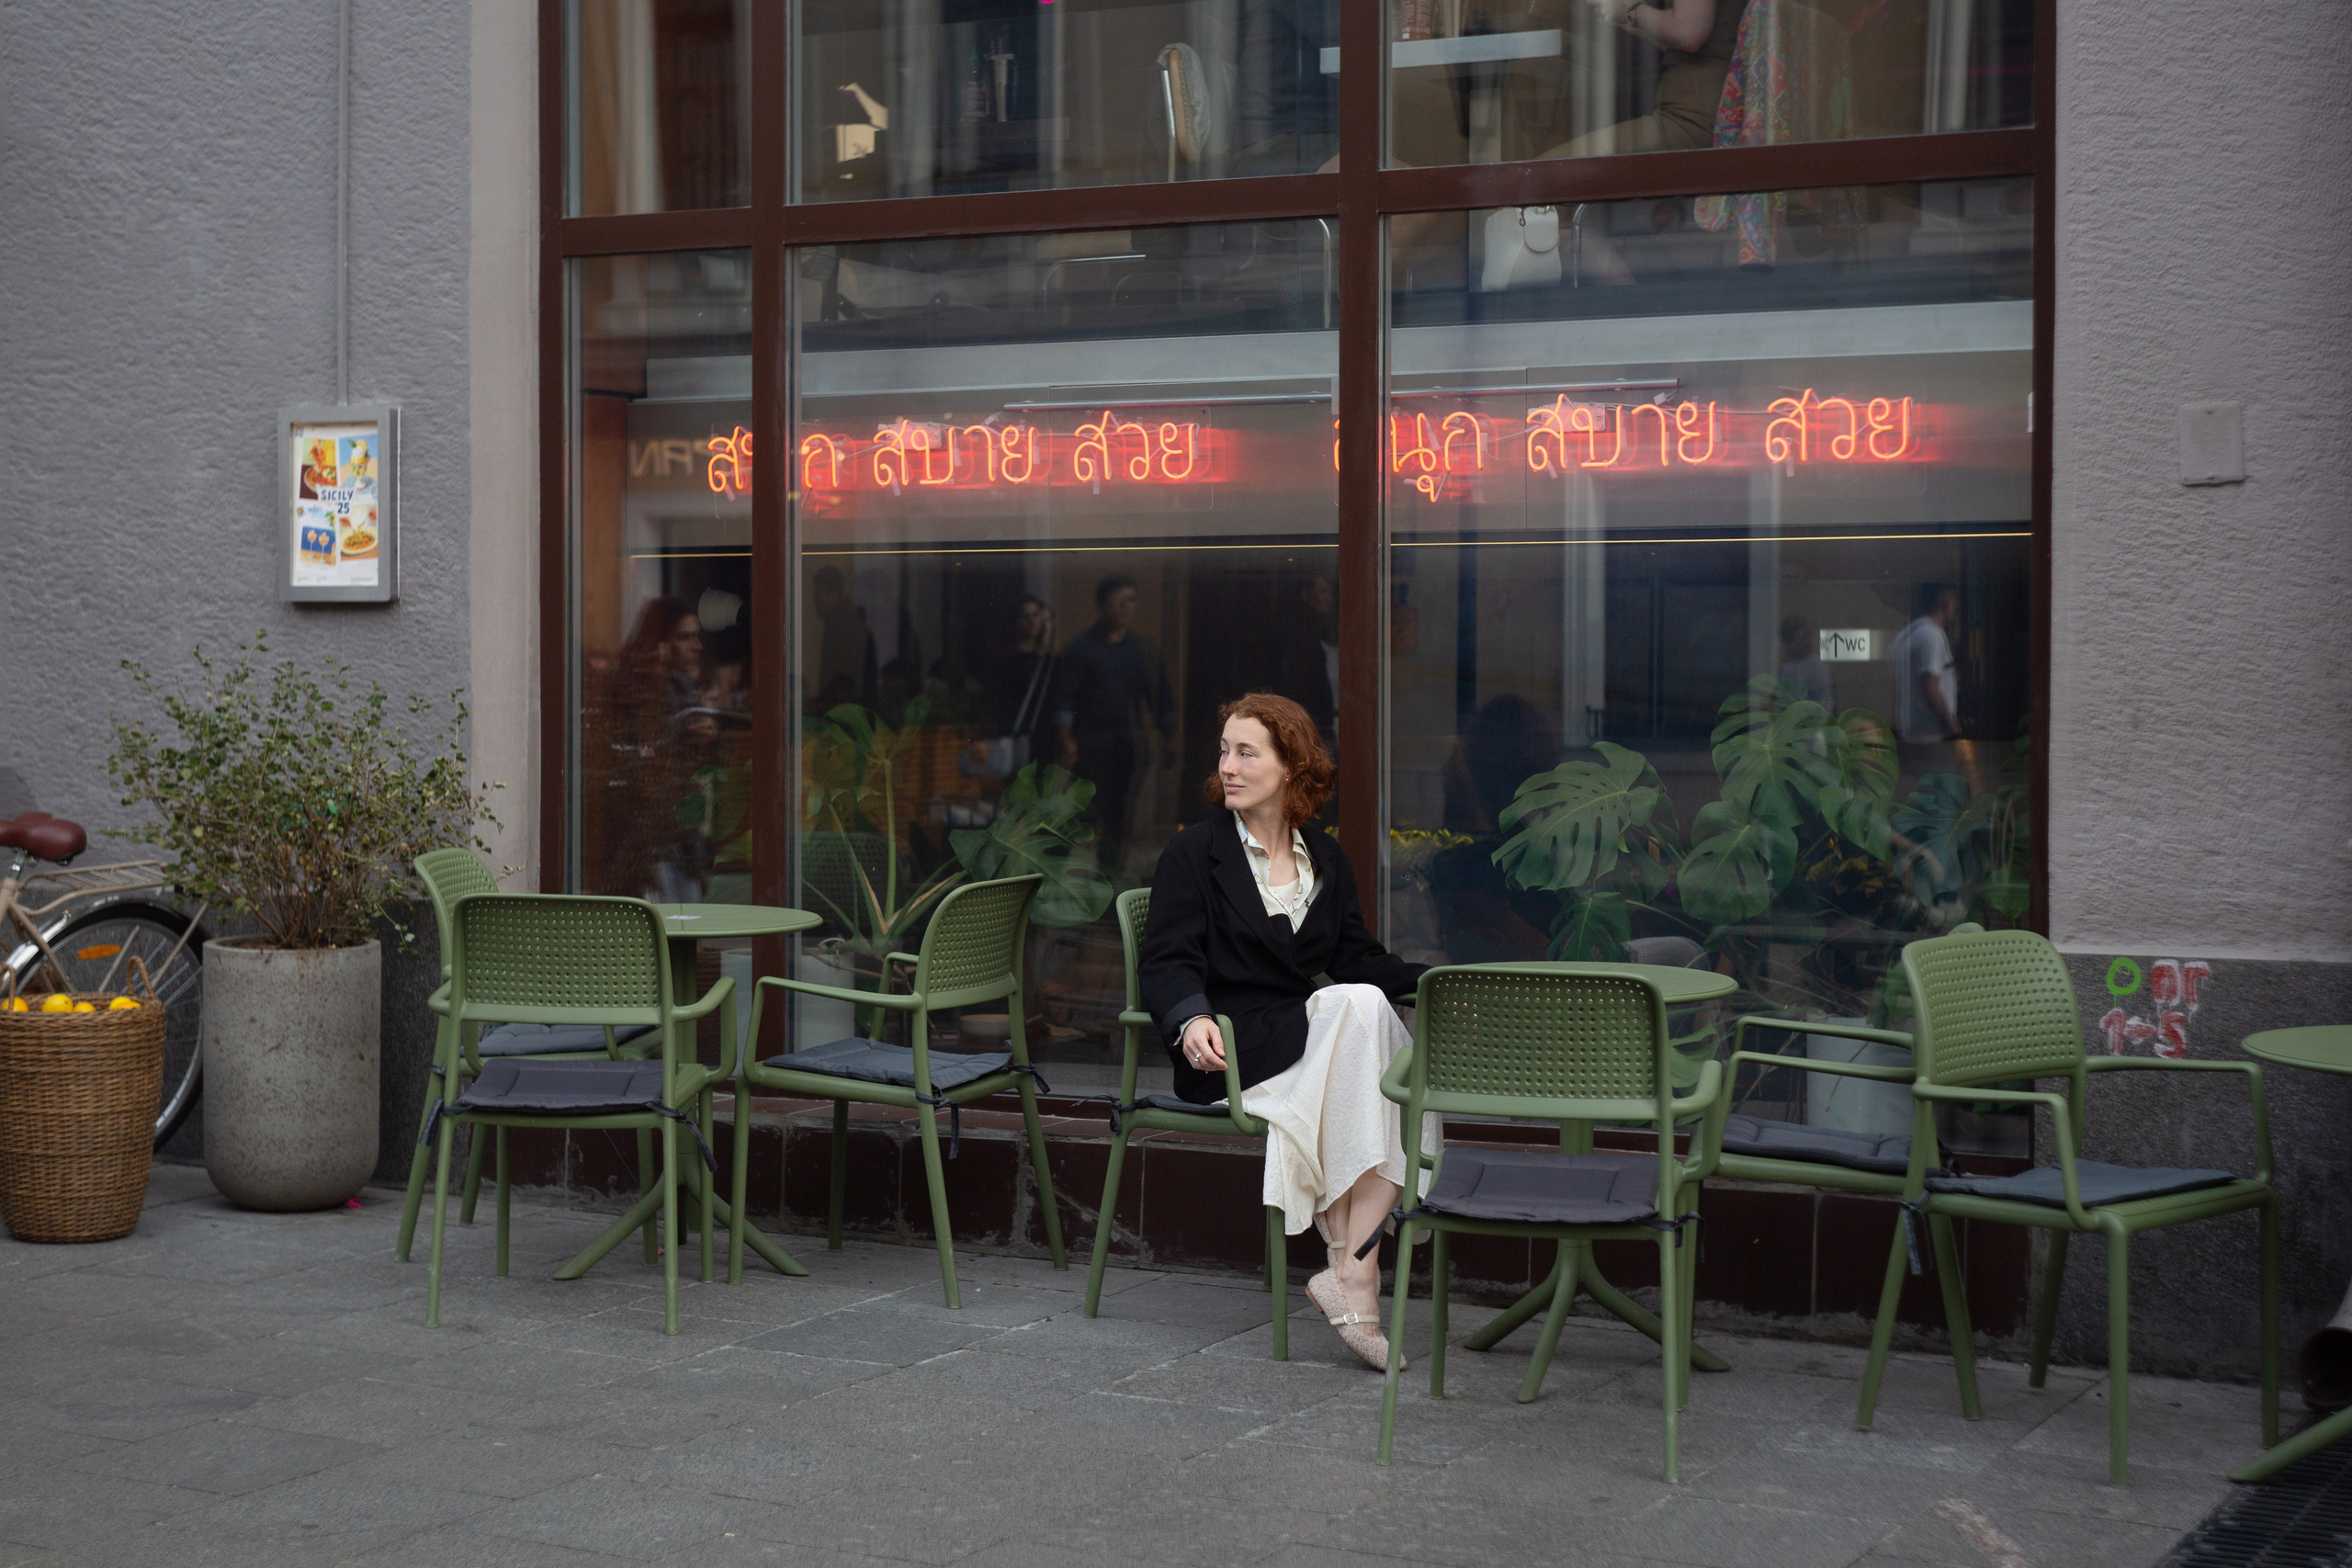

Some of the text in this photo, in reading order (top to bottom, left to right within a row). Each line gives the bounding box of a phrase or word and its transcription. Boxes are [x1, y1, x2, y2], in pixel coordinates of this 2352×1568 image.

[873, 419, 1035, 486] สบาย
[1074, 410, 1194, 482] สวย
[1526, 392, 1716, 471] สบาย
[1765, 388, 1911, 462] สวย
[321, 489, 355, 502] SICILY
[1845, 637, 1866, 652] WC
